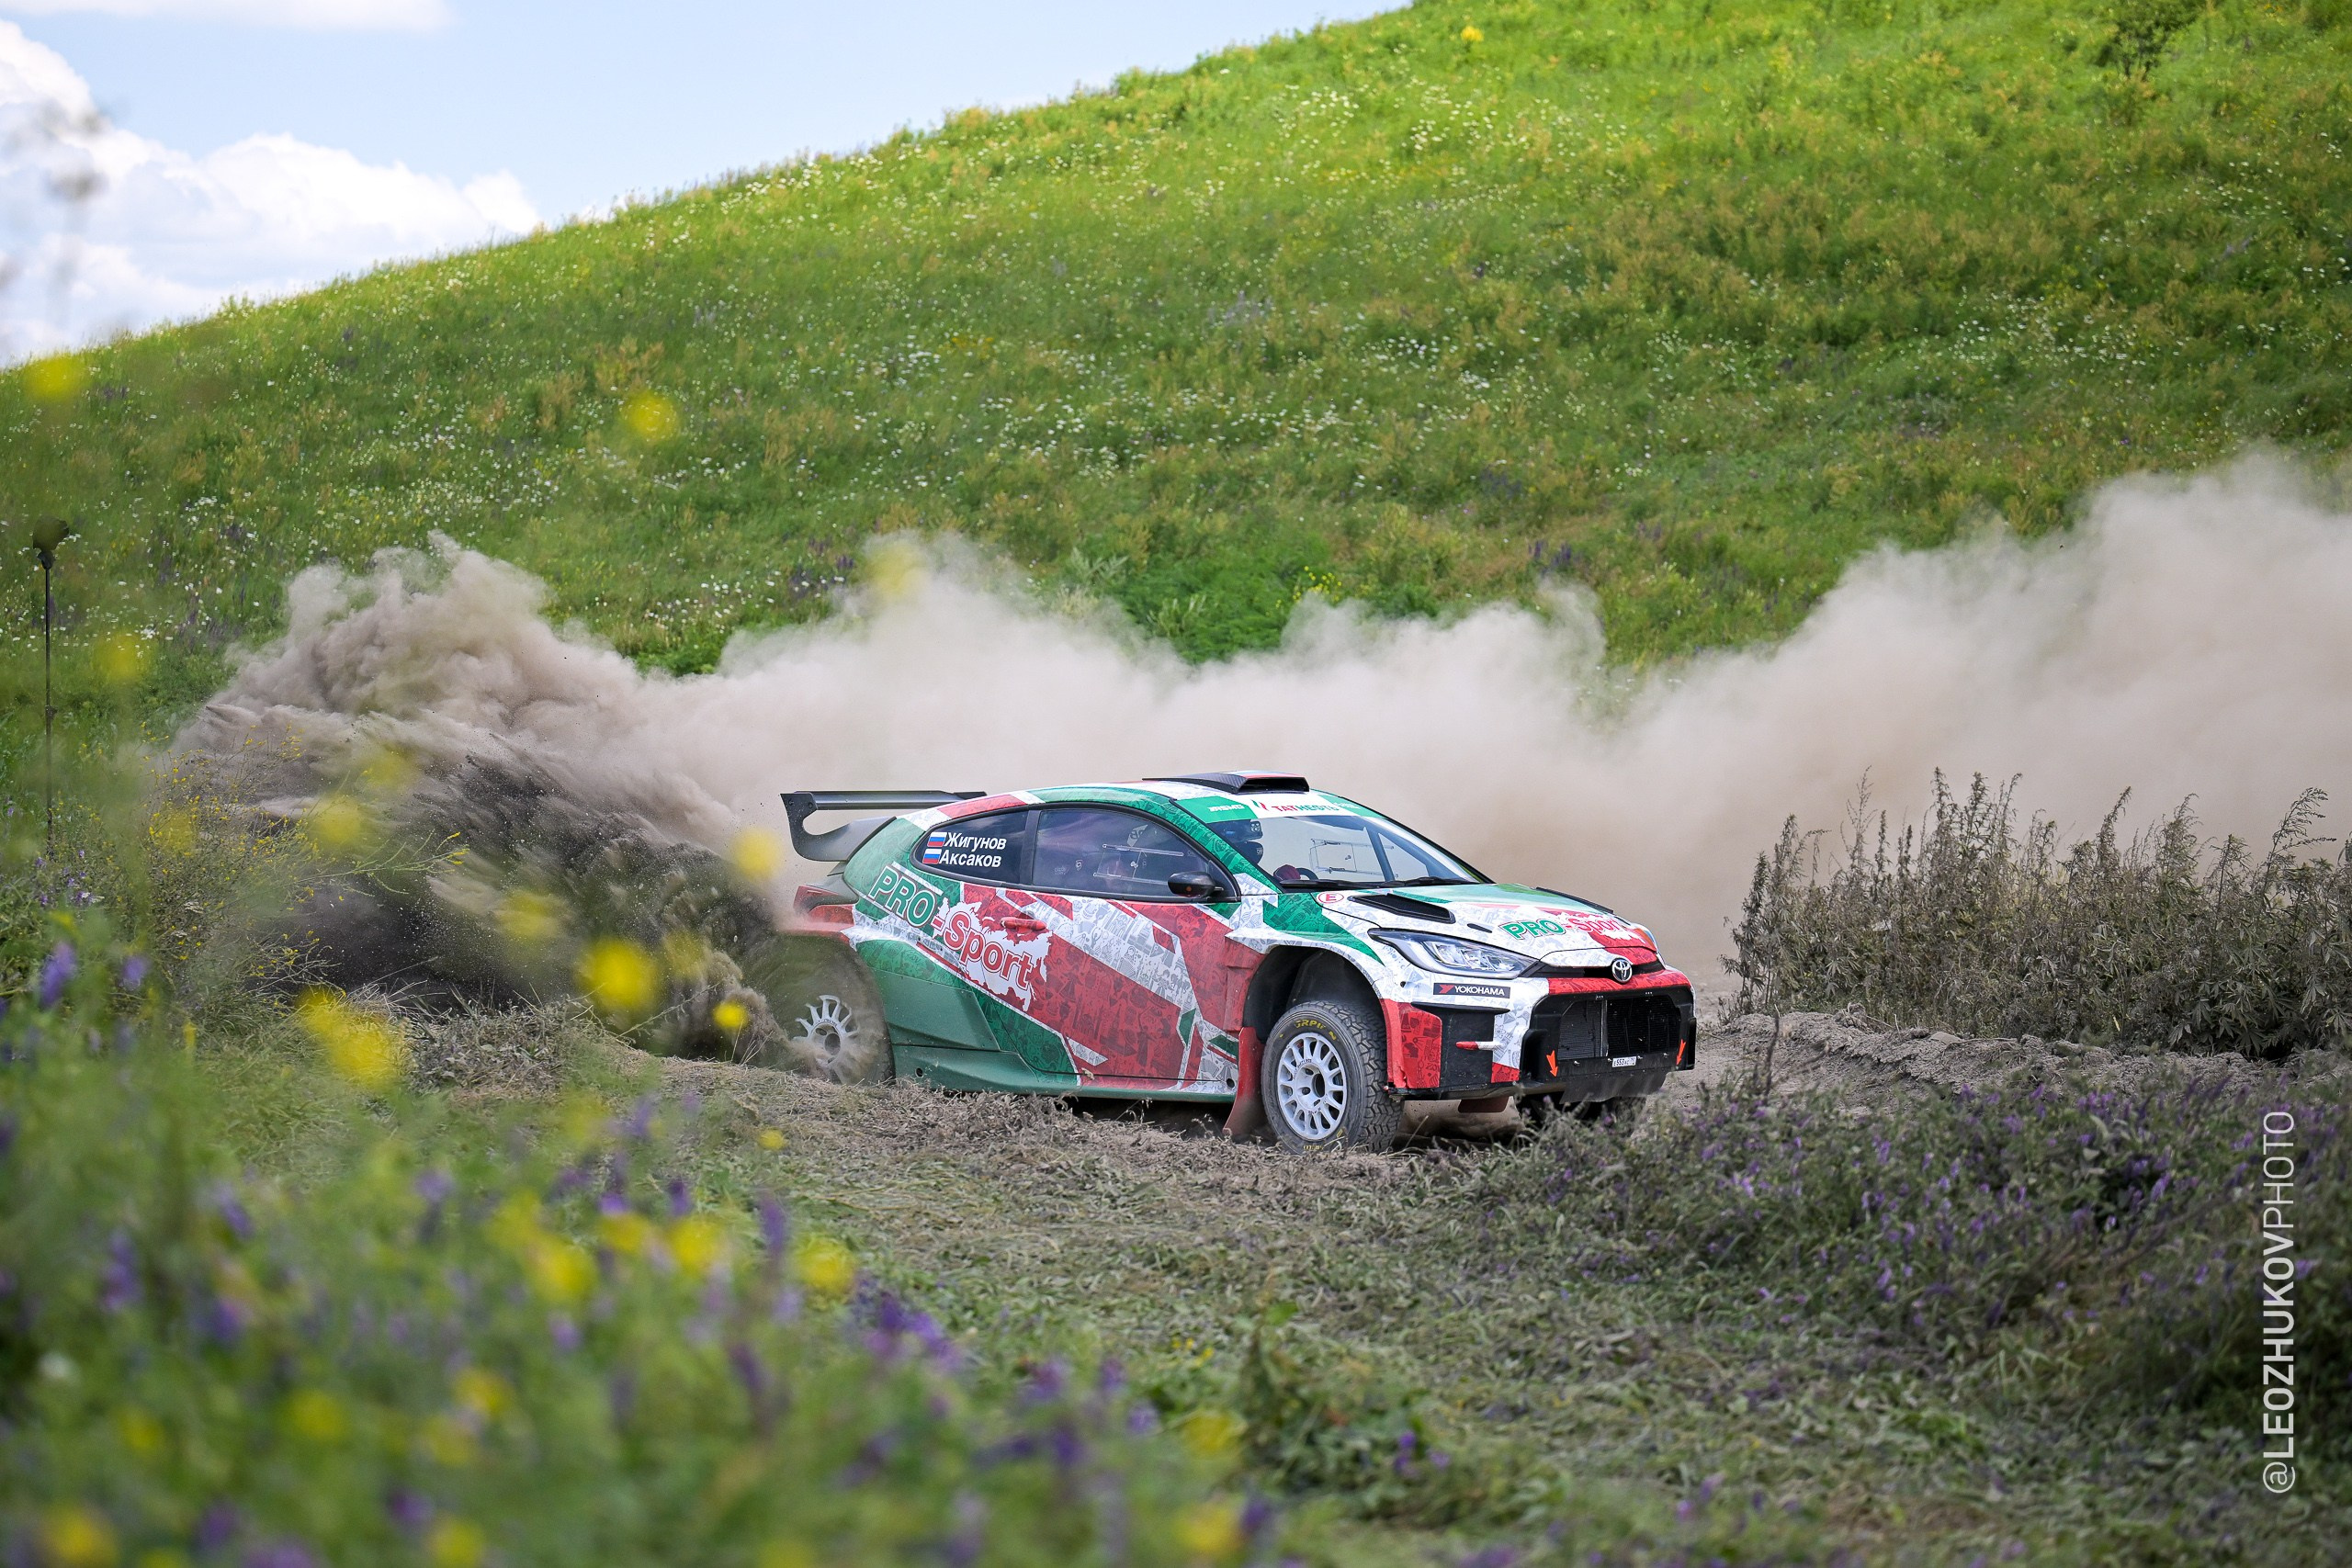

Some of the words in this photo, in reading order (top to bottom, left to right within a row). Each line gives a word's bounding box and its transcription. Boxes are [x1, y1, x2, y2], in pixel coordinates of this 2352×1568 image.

[944, 832, 1007, 852] Жигунов
[939, 850, 1001, 867] Аксаков
[867, 865, 1035, 989] PRO-Sport
[1454, 986, 1505, 996] YOKOHAMA
